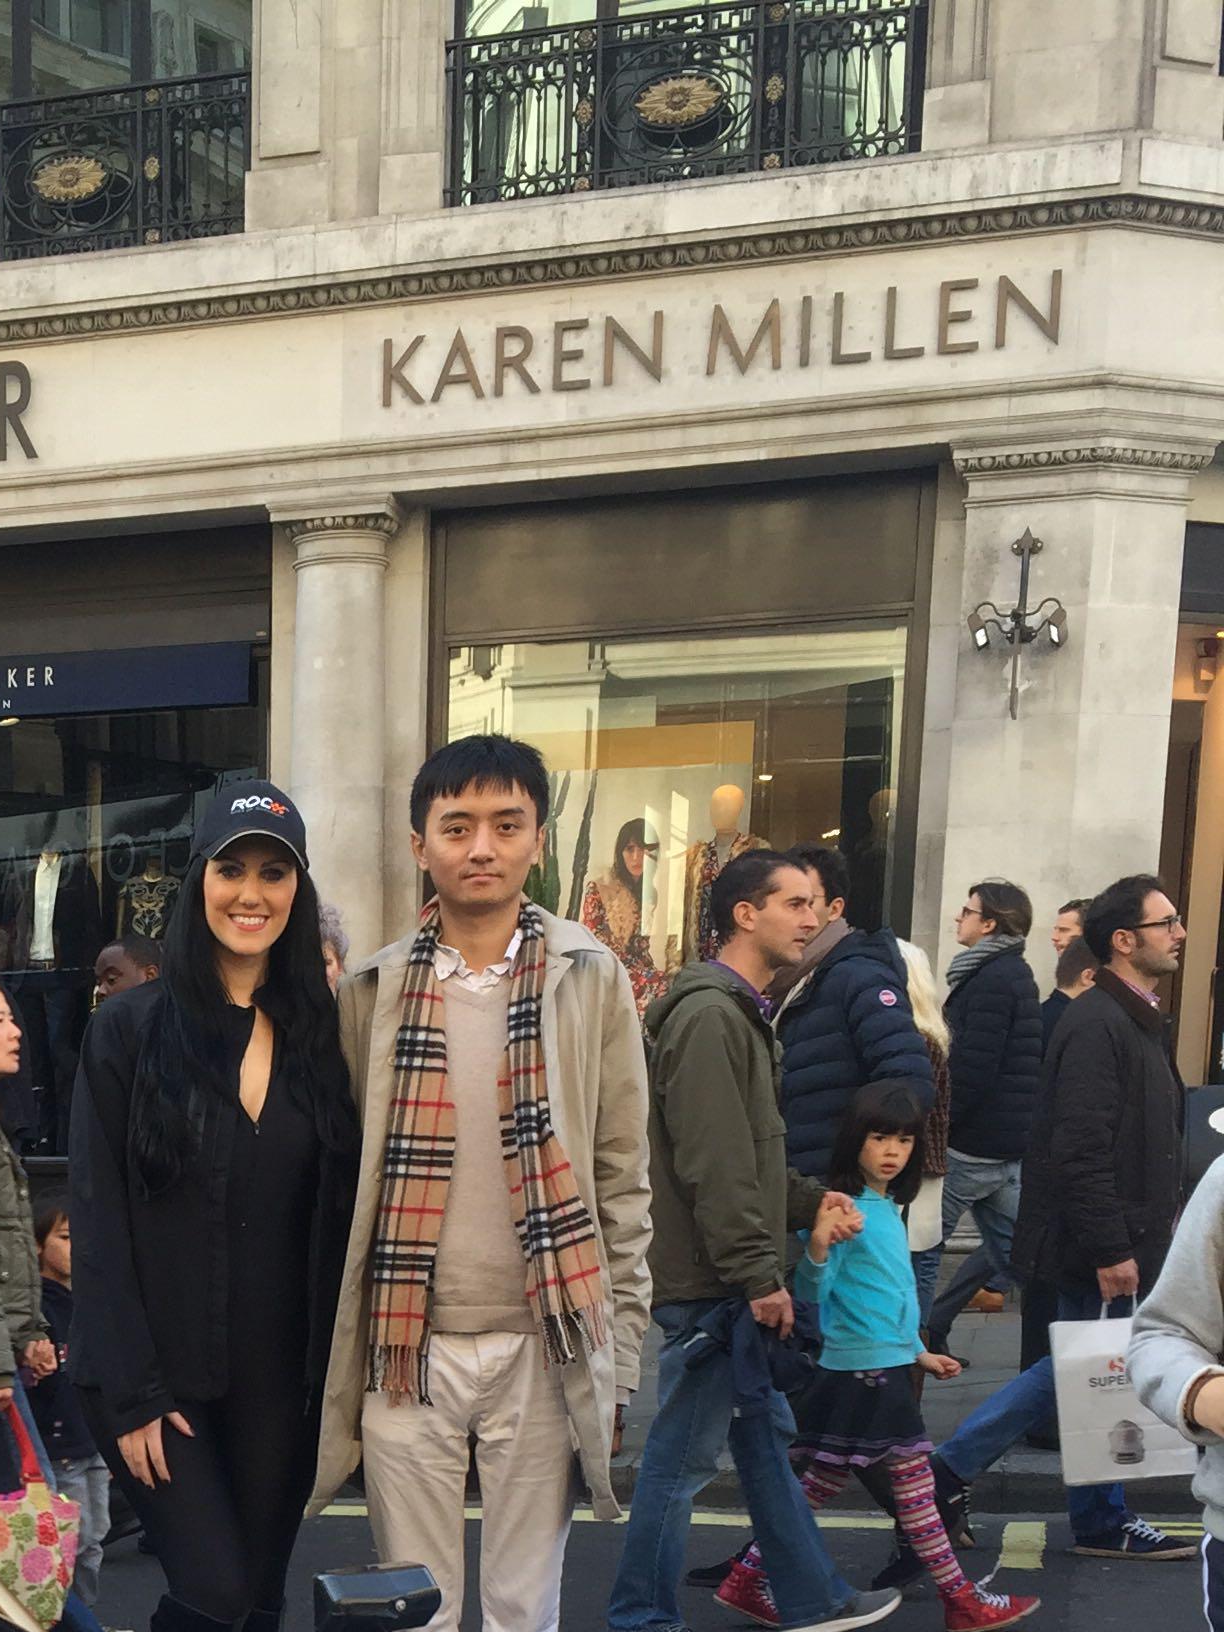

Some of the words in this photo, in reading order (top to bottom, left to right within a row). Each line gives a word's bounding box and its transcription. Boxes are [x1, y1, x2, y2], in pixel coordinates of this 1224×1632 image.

[381, 309, 664, 409] KAREN
[706, 269, 1064, 377] MILLEN
[230, 795, 274, 812] ROC
